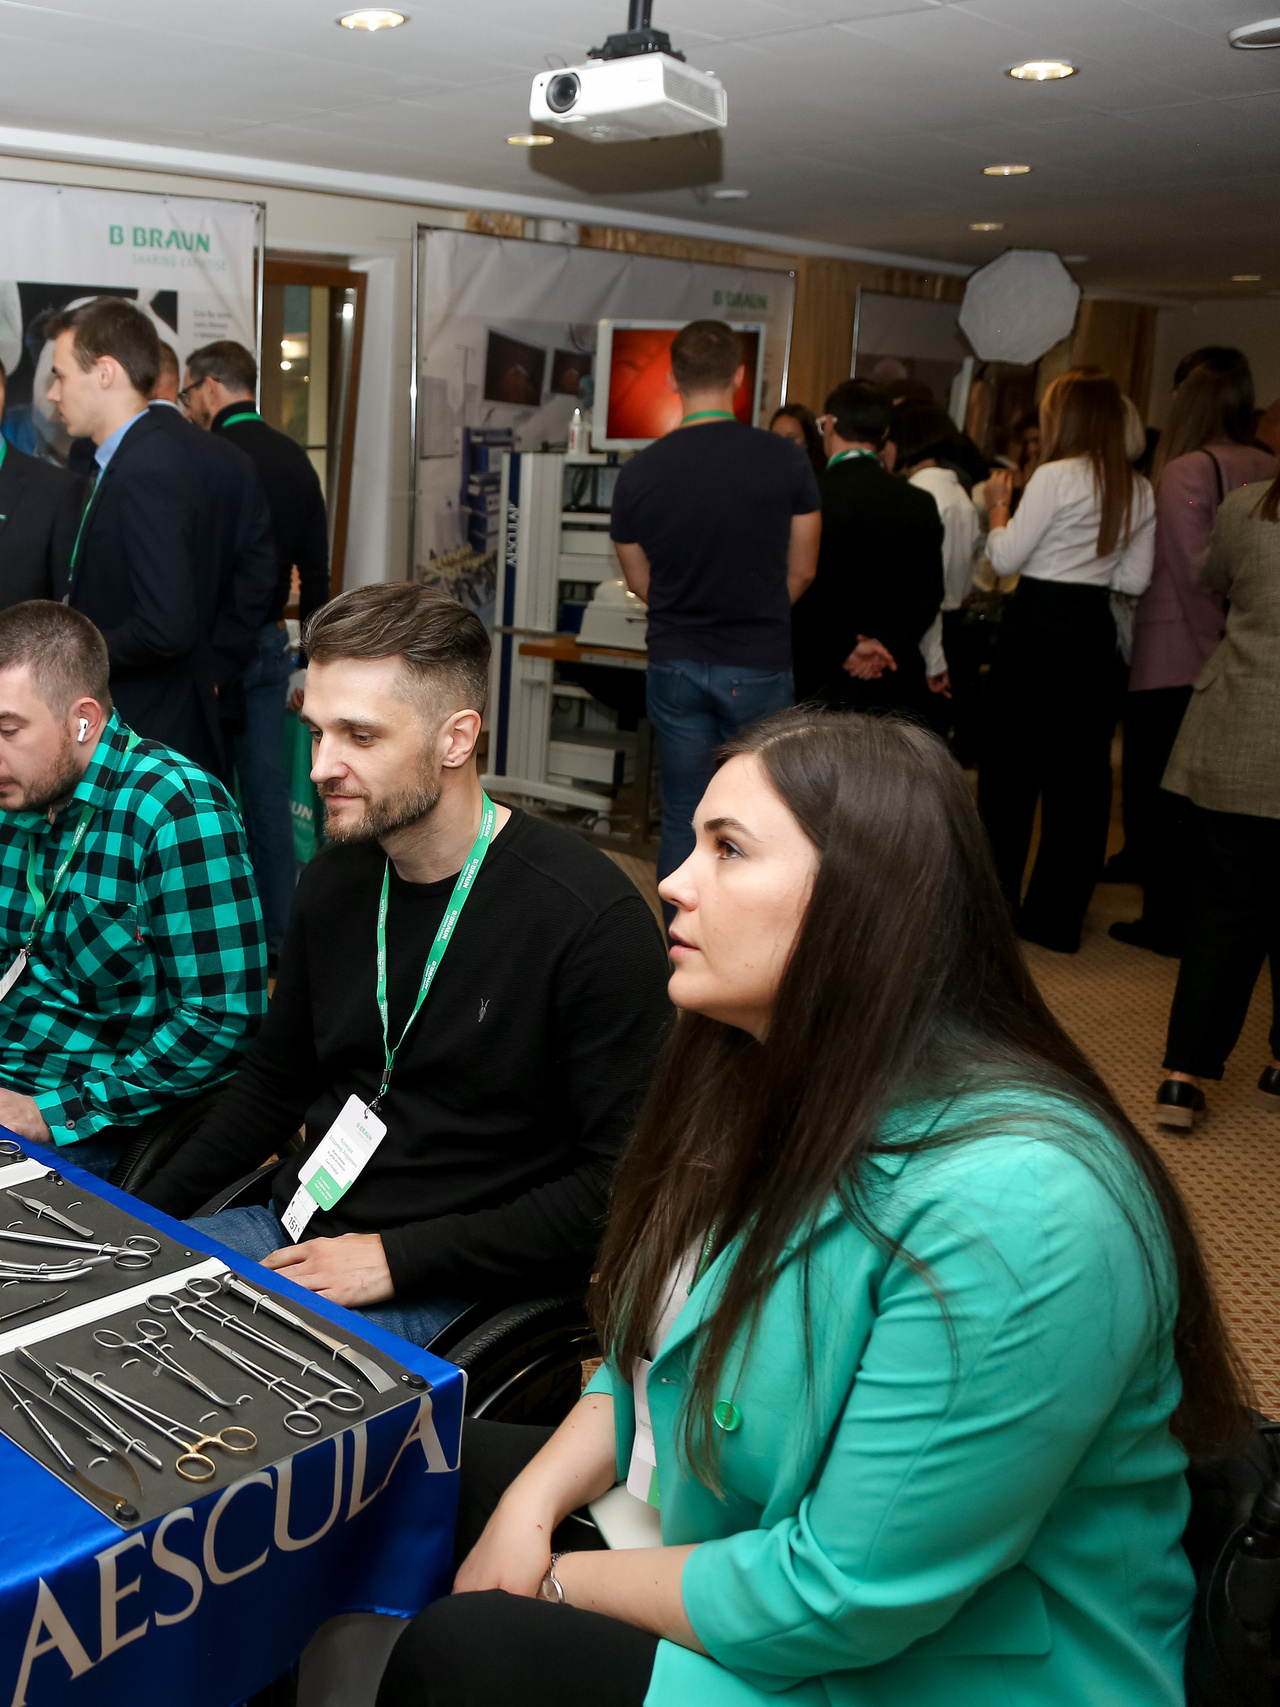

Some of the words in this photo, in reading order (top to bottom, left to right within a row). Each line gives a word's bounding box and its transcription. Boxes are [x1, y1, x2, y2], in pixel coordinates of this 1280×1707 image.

[110, 225, 124, 245] B
[132, 226, 211, 253] BRAUN
[506, 503, 520, 567] AESCULAP
[462, 865, 477, 889] BRAUN
[442, 915, 455, 940] BRAUN
[288, 1216, 298, 1233] 151
[10, 1392, 463, 1707] AESCULA
